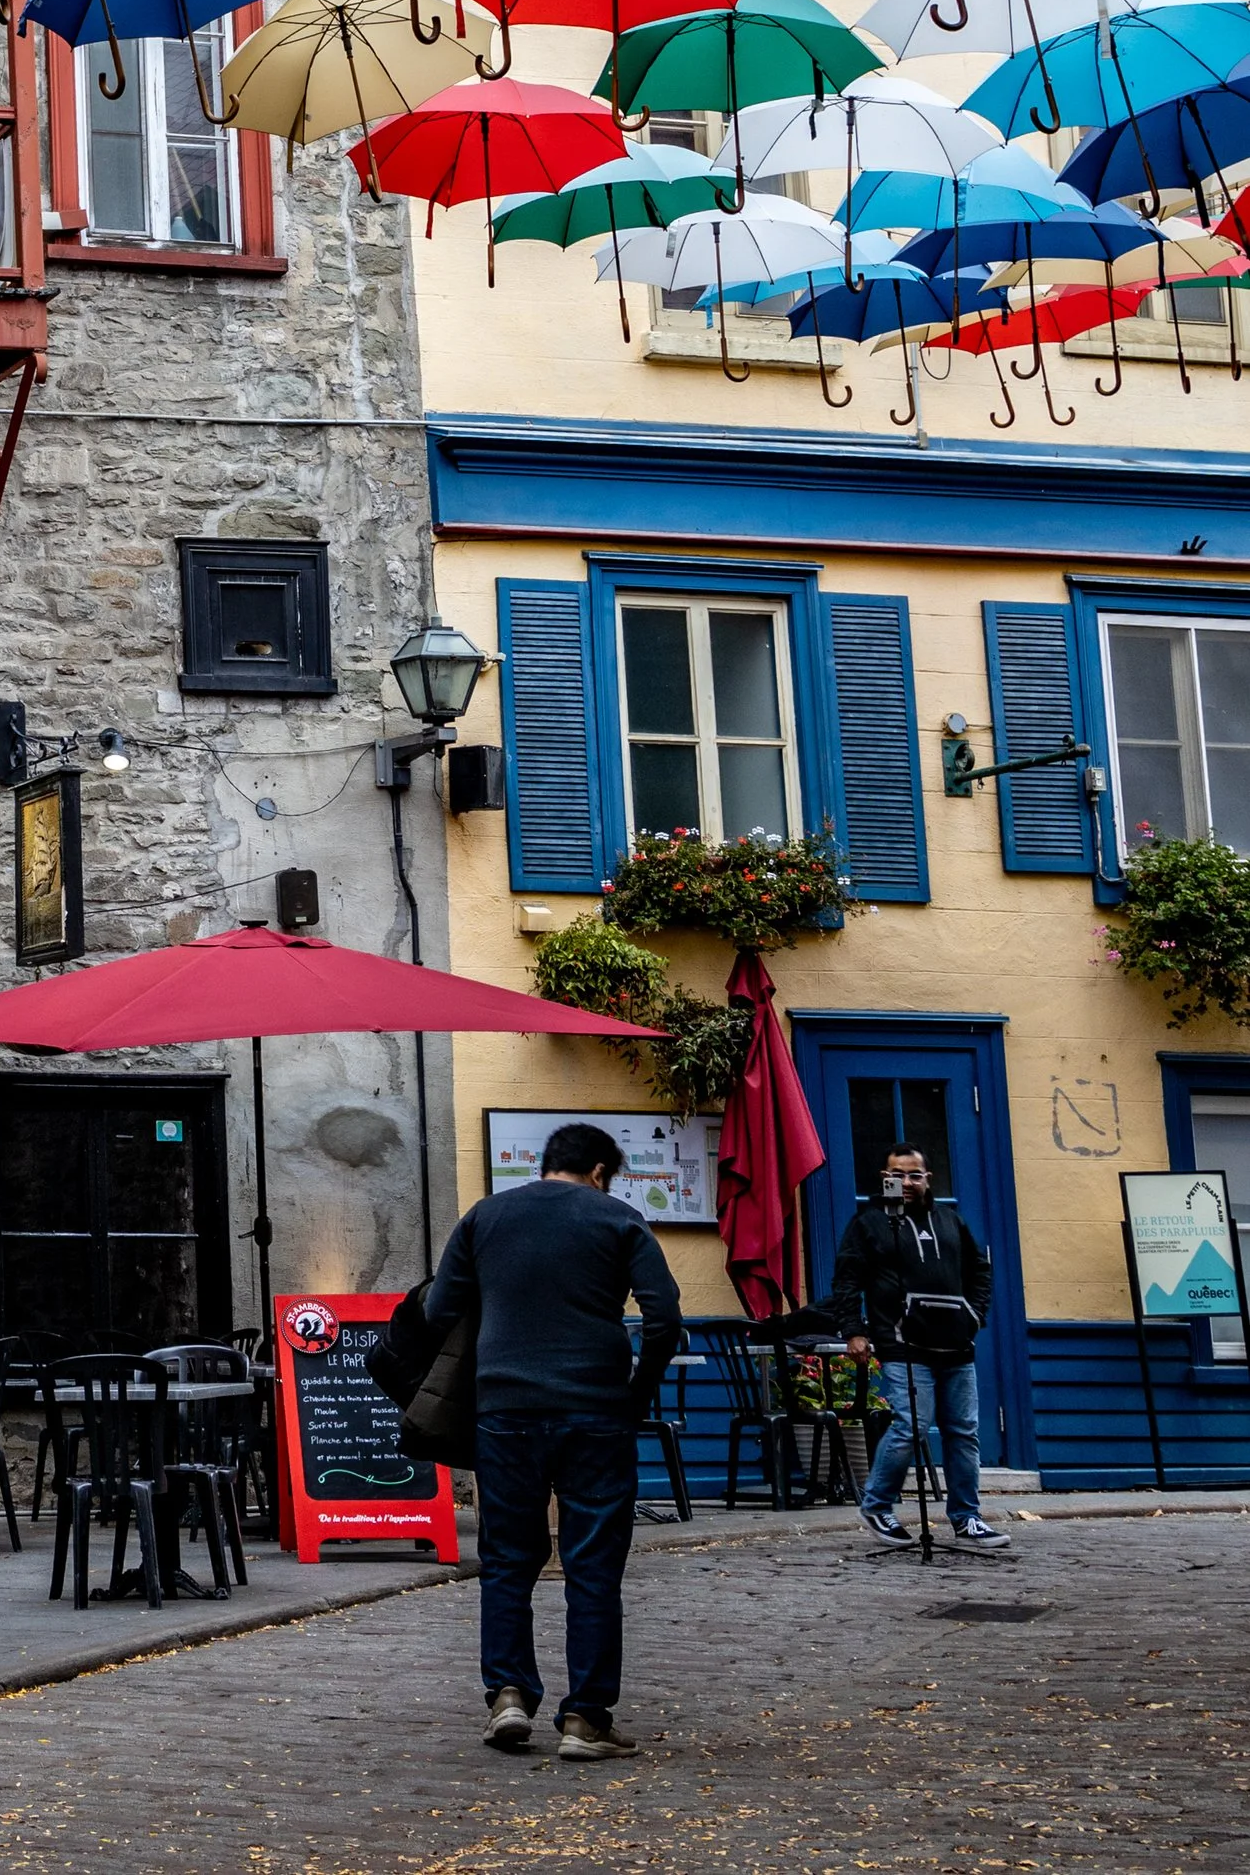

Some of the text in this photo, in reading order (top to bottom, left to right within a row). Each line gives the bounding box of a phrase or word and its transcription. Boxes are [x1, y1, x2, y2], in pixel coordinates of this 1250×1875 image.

[1185, 1181, 1224, 1223] LE PETIT CHAMPLAIN
[1134, 1215, 1195, 1226] LE RETOUR
[1136, 1226, 1226, 1237] DES PARAPLUIES
[286, 1303, 334, 1324] ST-AMBROISE
[327, 1353, 338, 1366] LE
[318, 1513, 432, 1524] De la tradition à l'inspiration
